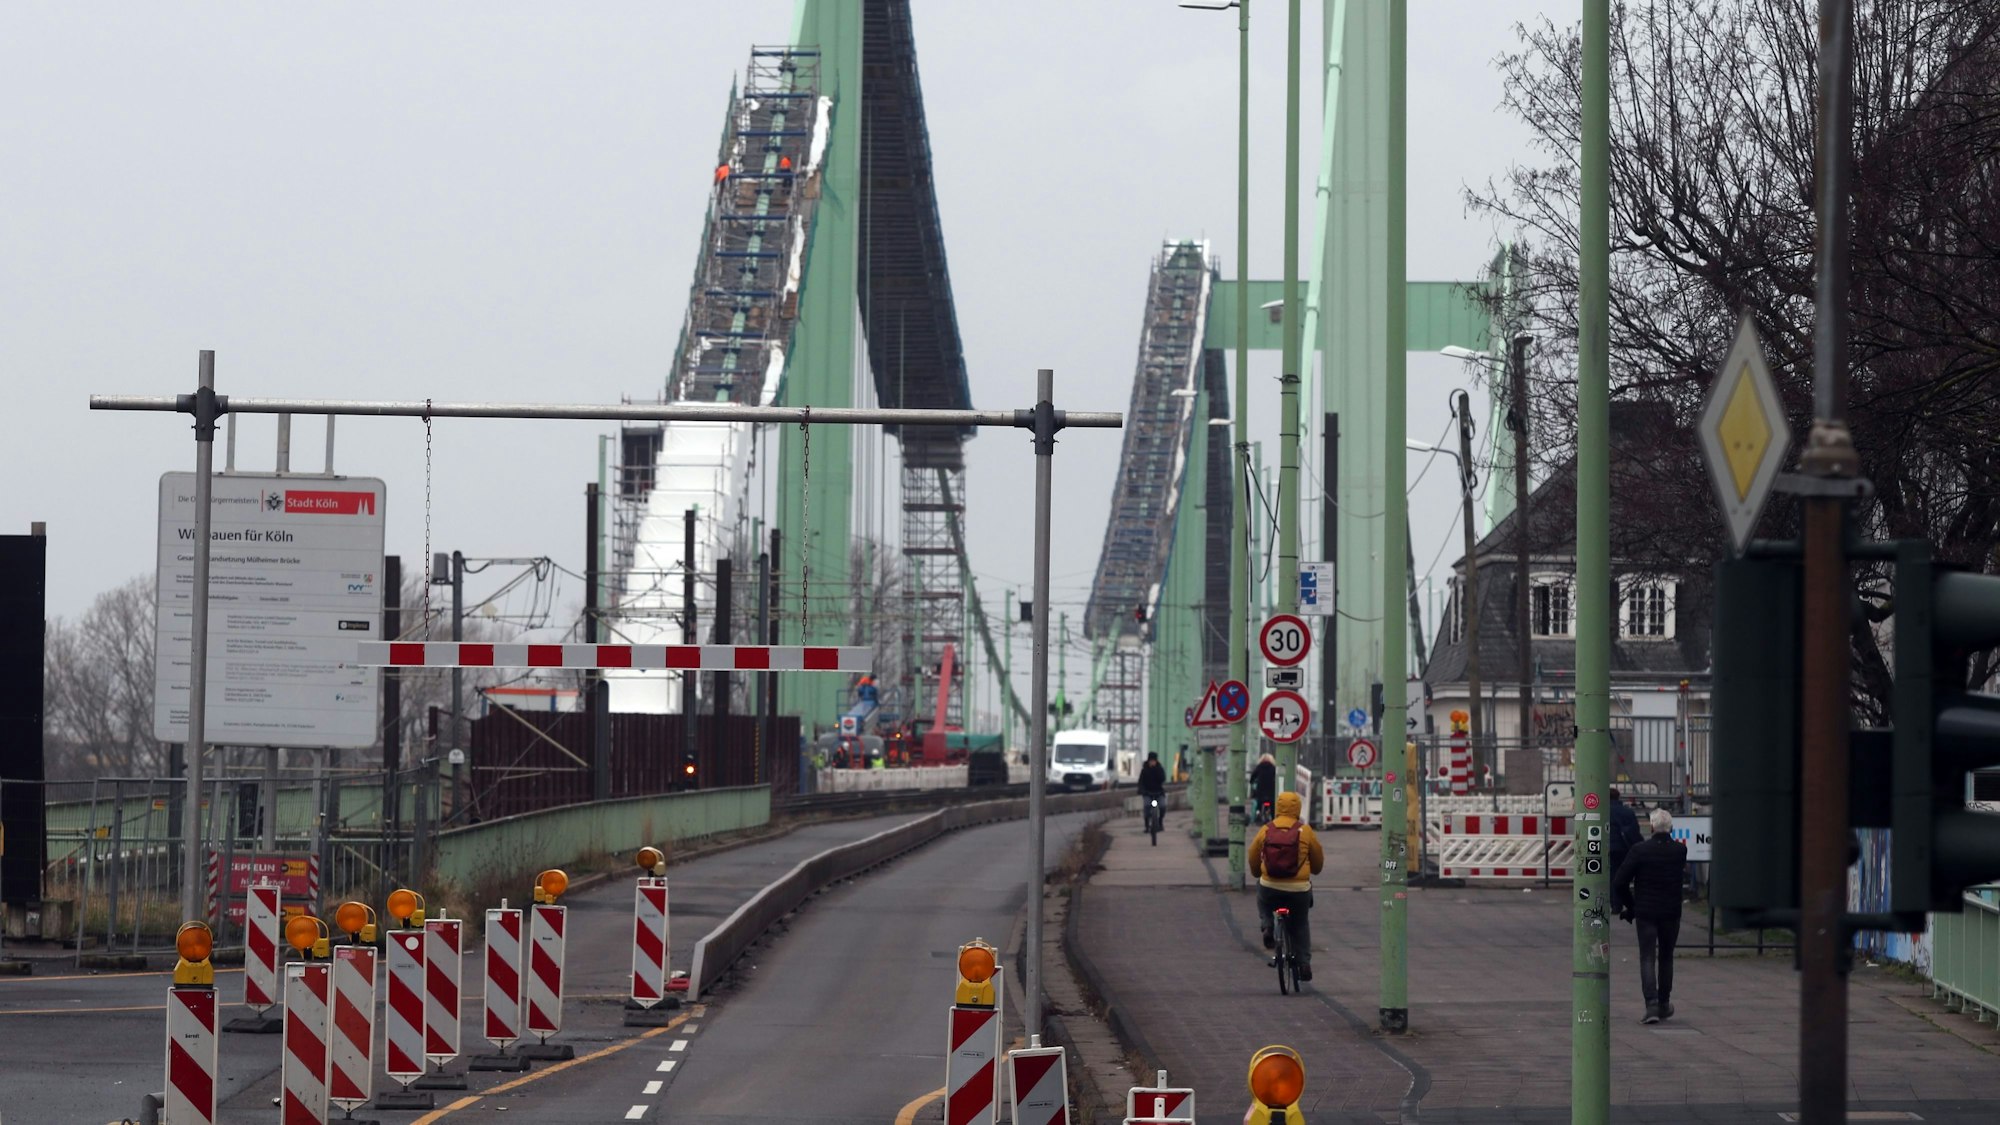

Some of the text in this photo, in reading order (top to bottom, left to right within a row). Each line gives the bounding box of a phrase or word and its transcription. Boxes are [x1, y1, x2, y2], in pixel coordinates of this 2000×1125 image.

[287, 497, 339, 509] Stadt Köln
[178, 528, 195, 540] Wi
[245, 529, 263, 541] für
[265, 530, 294, 542] Köln
[246, 555, 279, 564] Mülheimer
[280, 556, 301, 565] Brücke
[1270, 628, 1300, 652] 30
[1588, 841, 1601, 852] G1
